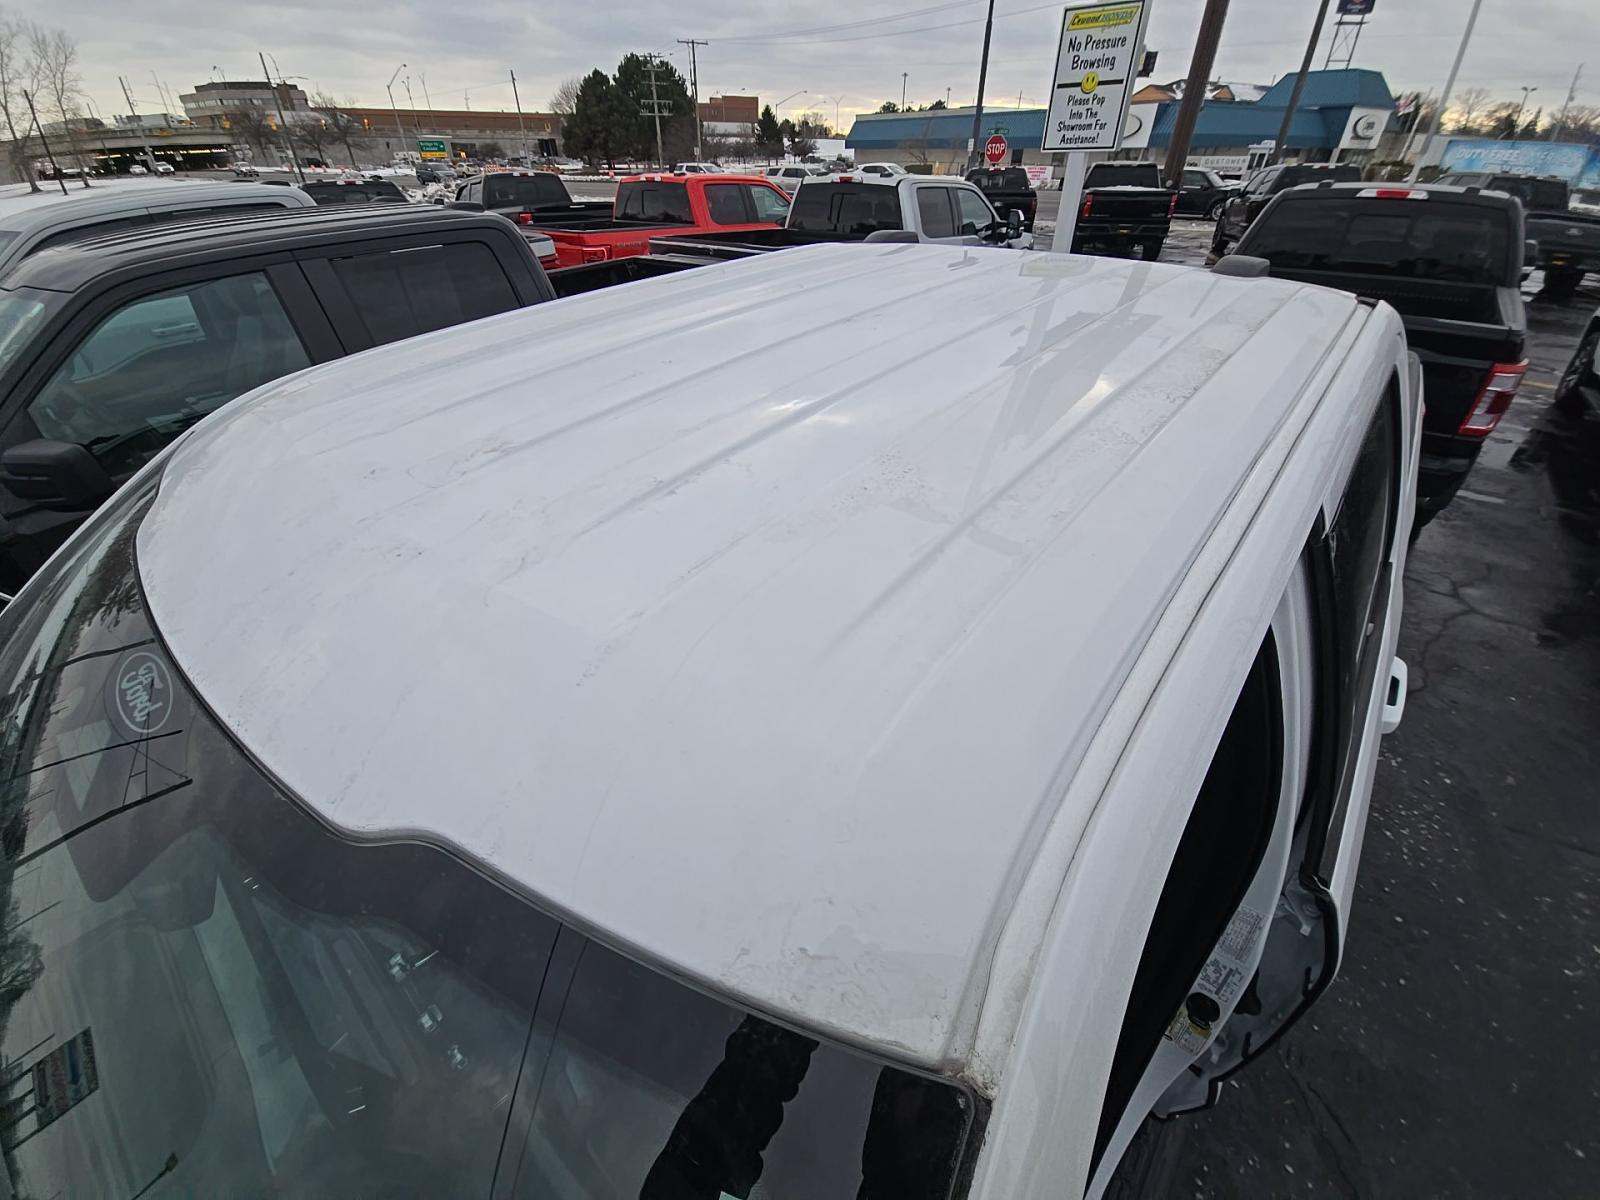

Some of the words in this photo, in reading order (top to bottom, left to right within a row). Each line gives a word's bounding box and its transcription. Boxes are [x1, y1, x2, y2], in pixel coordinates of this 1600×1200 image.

[1068, 36, 1082, 53] No
[1084, 34, 1127, 51] Pressure
[1071, 53, 1116, 71] Browsing
[1067, 95, 1090, 106] Please
[1091, 94, 1106, 107] Pop
[1069, 109, 1083, 120] Into
[1085, 108, 1098, 120] The
[1057, 120, 1093, 132] Showroom
[1094, 119, 1107, 130] For
[1059, 132, 1100, 145] Assistance!
[987, 143, 1006, 155] STOP
[1456, 149, 1488, 160] DUTY
[1491, 150, 1520, 161] FREE
[120, 662, 163, 722] Ford
